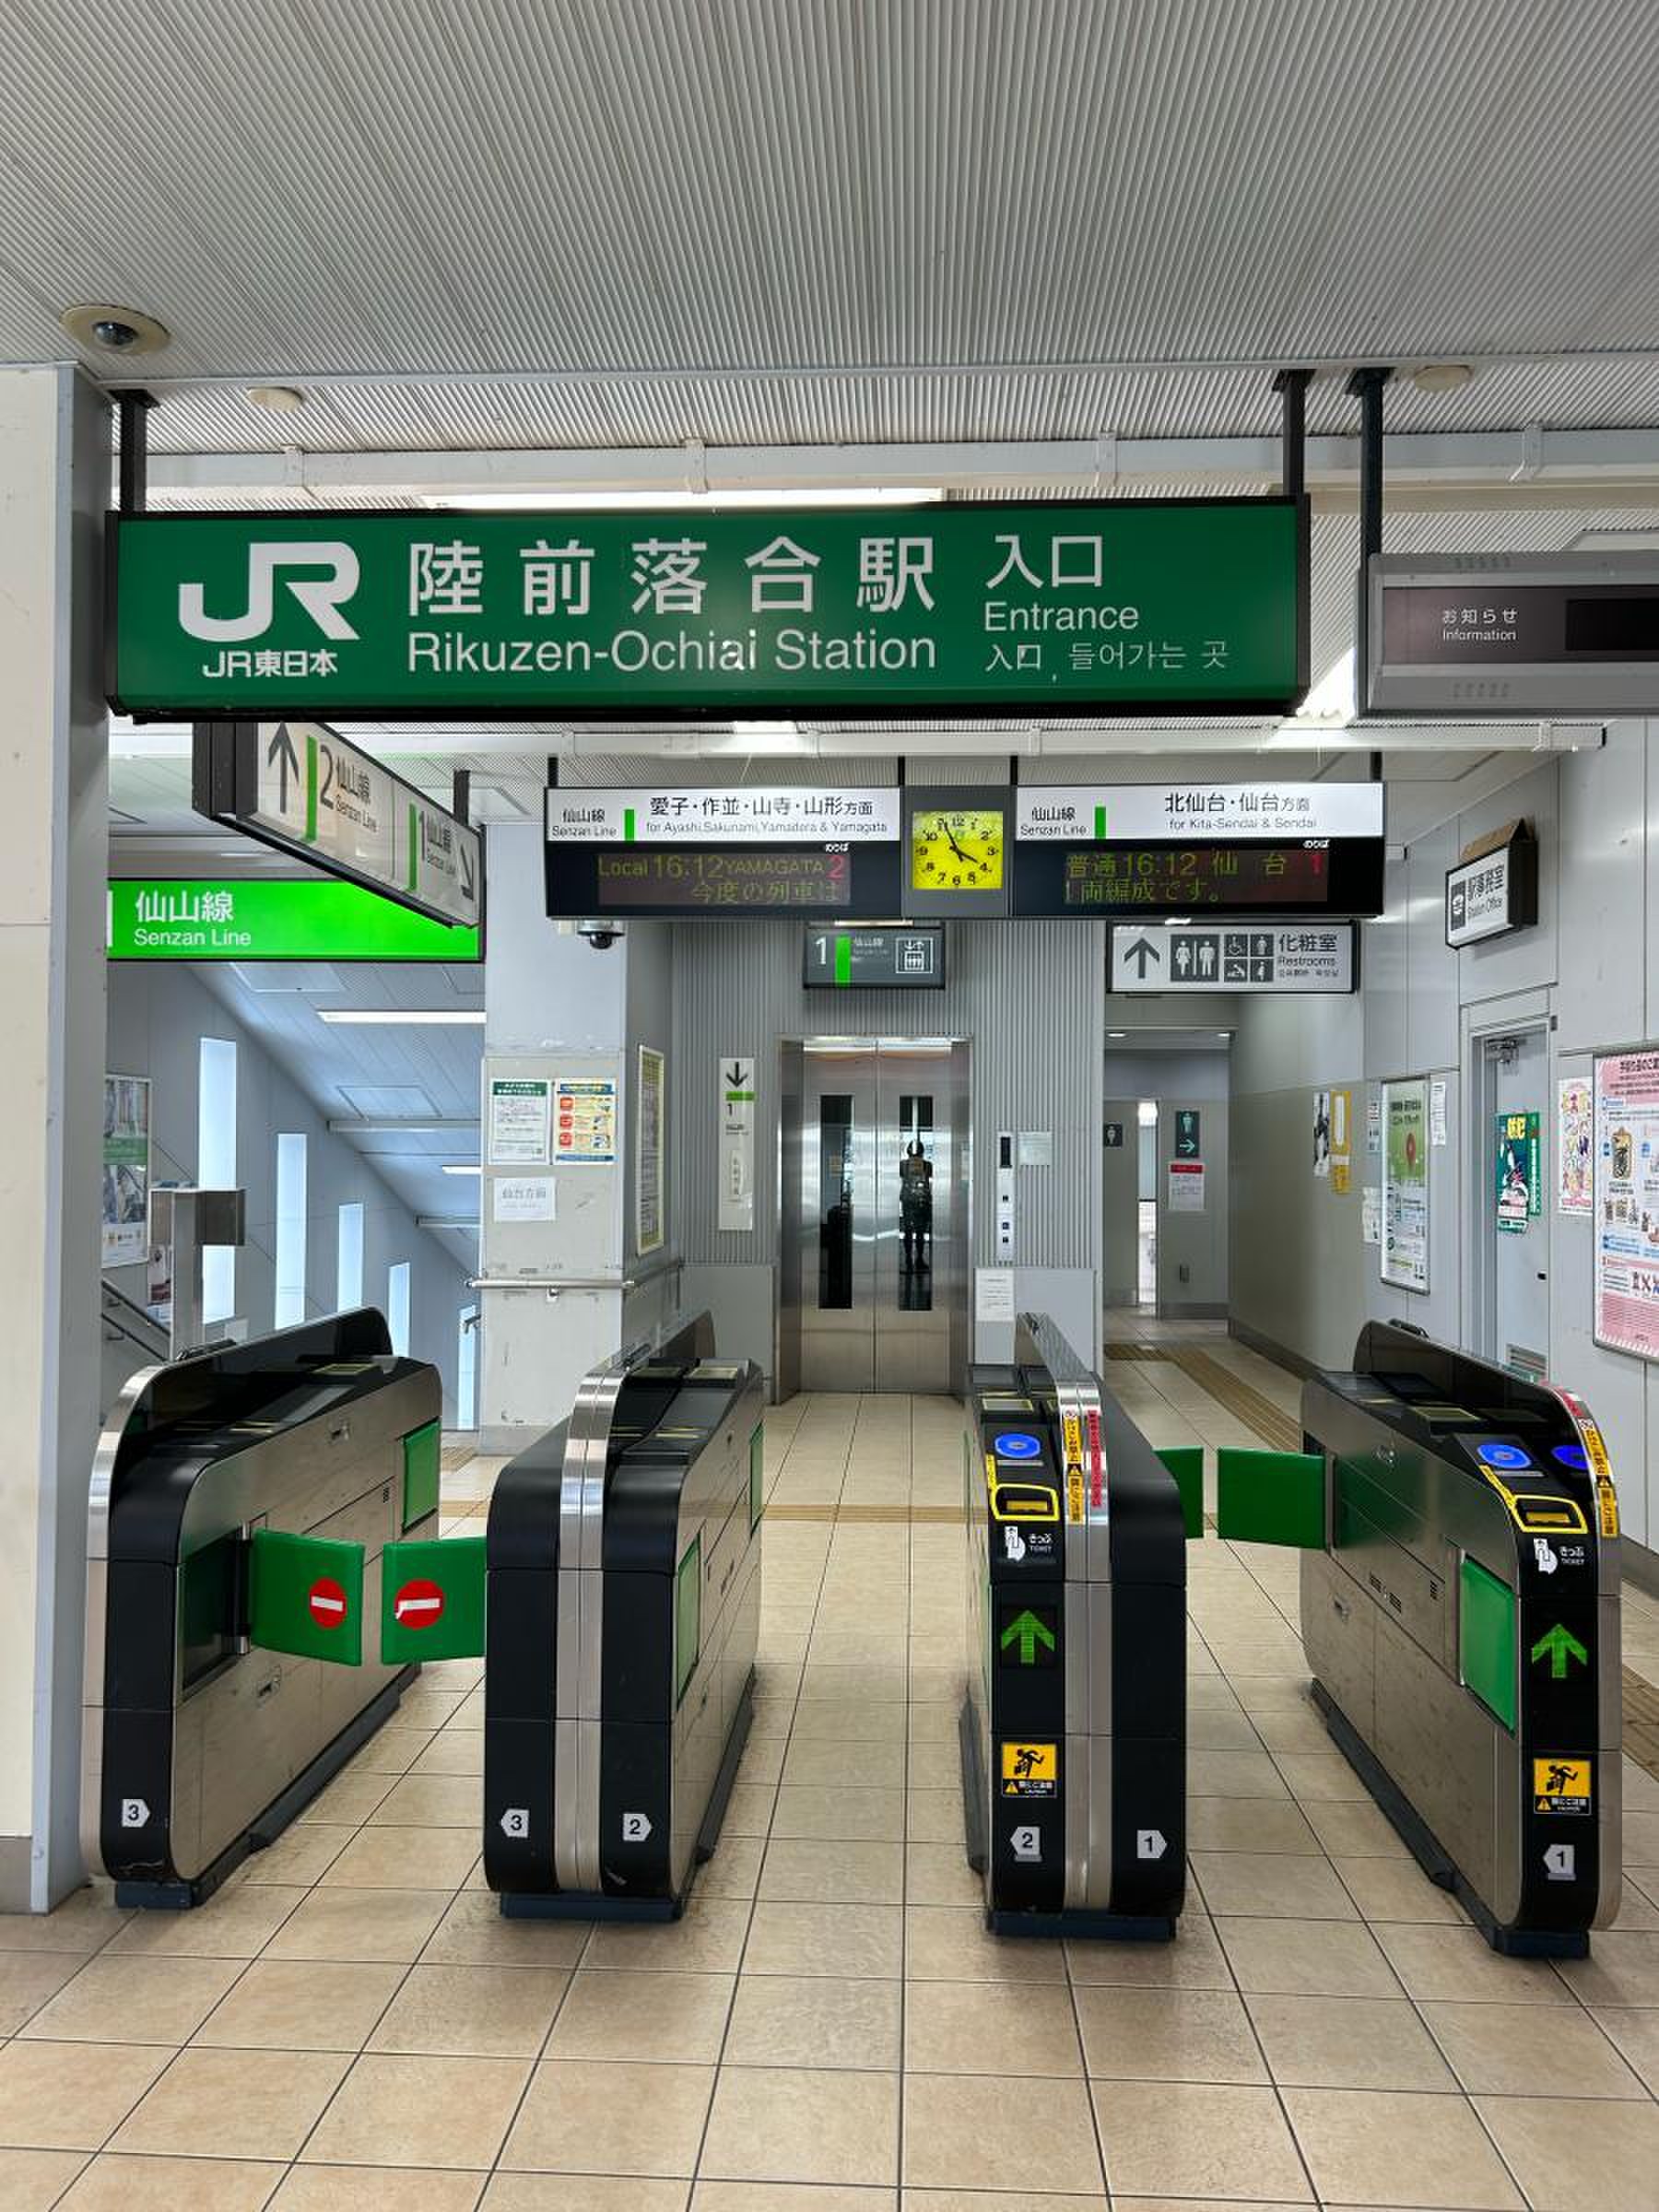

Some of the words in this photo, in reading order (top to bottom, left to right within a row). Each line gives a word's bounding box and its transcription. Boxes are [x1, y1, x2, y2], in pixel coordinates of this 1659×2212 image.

[985, 535, 1103, 589] 入口
[408, 535, 935, 617] 陸前落合駅
[179, 542, 360, 642] JR
[984, 601, 1139, 631] Entrance
[1442, 607, 1518, 625] お知らせ
[1442, 629, 1517, 641] Information
[408, 629, 756, 672] Rikuzen-Ochiai
[775, 629, 935, 670] Station
[985, 644, 1041, 672] 入口
[1068, 641, 1187, 671] 들어가는
[1201, 641, 1229, 669] 곳
[202, 649, 338, 678] JR東日本
[320, 745, 334, 809] 2
[562, 808, 606, 823] 仙山線
[1169, 818, 1185, 830] for
[1275, 818, 1316, 829] Sendai
[646, 822, 661, 833] for
[598, 854, 649, 876] Local
[724, 858, 824, 874] YAMAGATA
[828, 855, 844, 880] 2
[1066, 853, 1116, 878] 普通
[135, 889, 235, 924] 仙山線
[134, 928, 207, 947] Senzan
[211, 928, 252, 947] Line
[1278, 933, 1337, 952] 化粧室
[816, 936, 827, 965] 1
[1277, 956, 1335, 967] Restrooms
[1559, 1546, 1584, 1558] きっぷ
[127, 1804, 140, 1822] 3
[510, 1814, 523, 1831] 3
[629, 1818, 641, 1835] 2
[1021, 1831, 1033, 1849] 2
[1144, 1835, 1153, 1853] 1
[1556, 1850, 1565, 1868] 1
